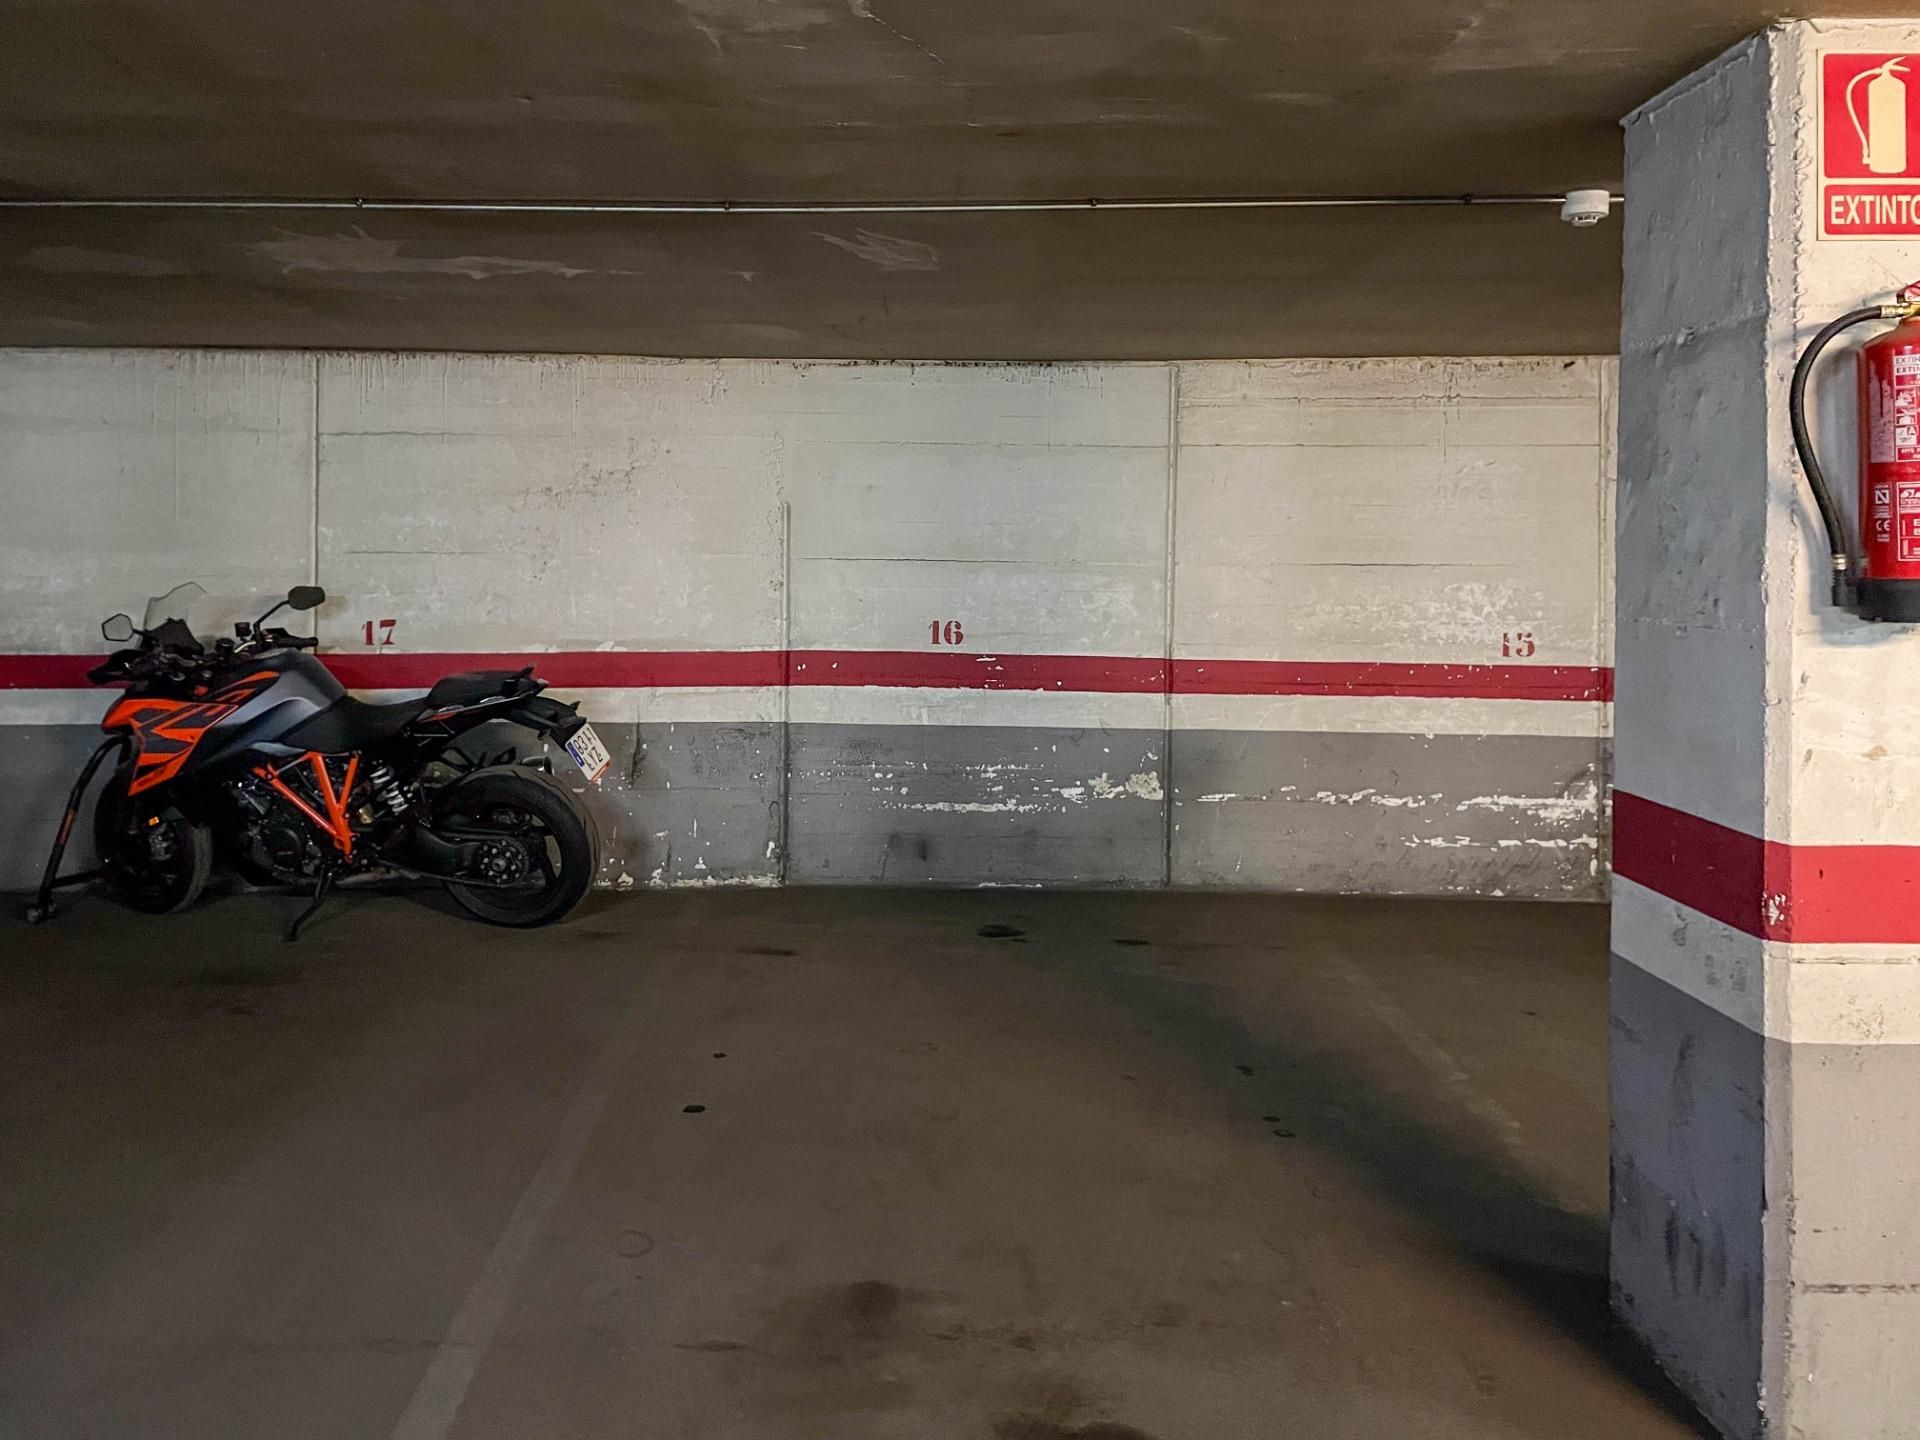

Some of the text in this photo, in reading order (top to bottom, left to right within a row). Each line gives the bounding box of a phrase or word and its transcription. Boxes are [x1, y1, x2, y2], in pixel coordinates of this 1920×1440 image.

[361, 619, 397, 646] 17
[928, 620, 964, 645] 16
[1501, 632, 1535, 658] 15
